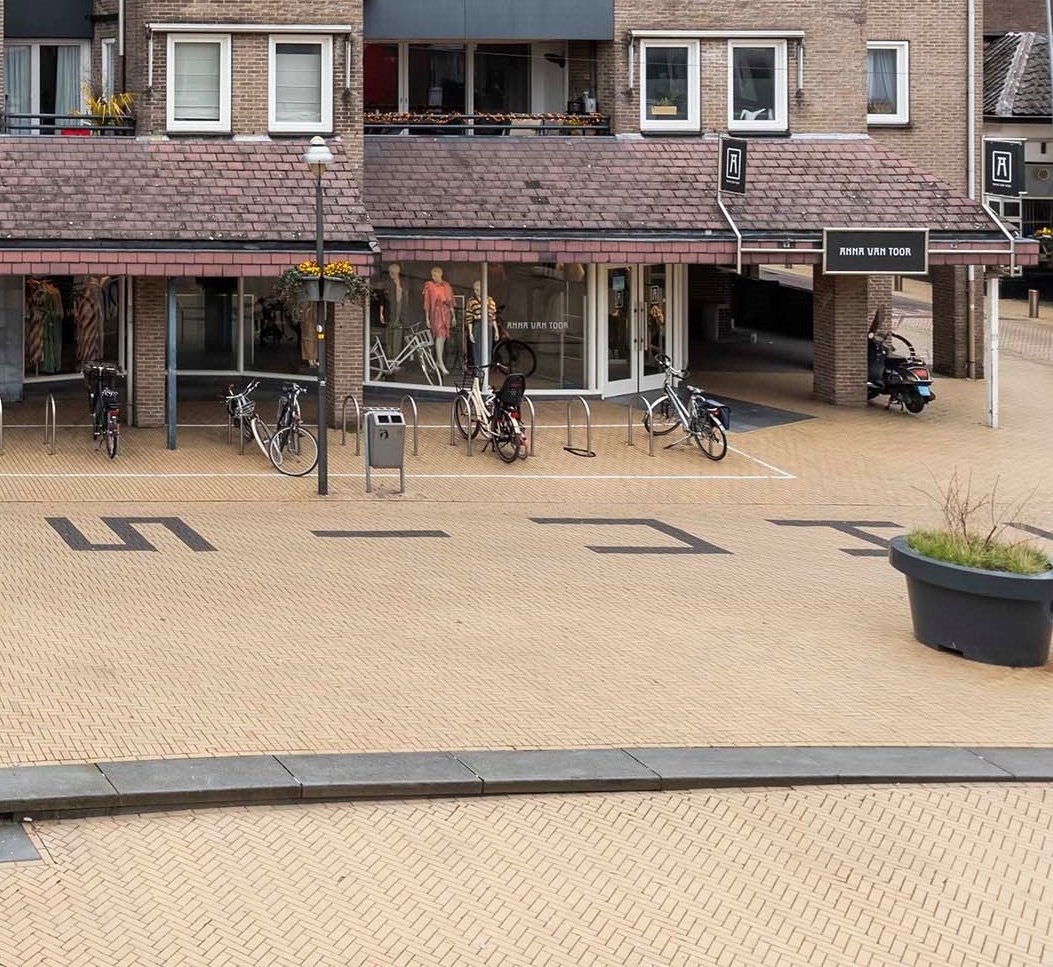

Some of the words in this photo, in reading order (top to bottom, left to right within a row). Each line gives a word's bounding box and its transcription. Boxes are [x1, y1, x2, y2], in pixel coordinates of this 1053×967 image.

[839, 247, 865, 256] ANNA
[867, 247, 886, 256] VAN
[888, 247, 912, 257] TOOR
[506, 321, 528, 330] ANNA
[530, 321, 547, 330] VAN
[548, 321, 568, 330] TOOR
